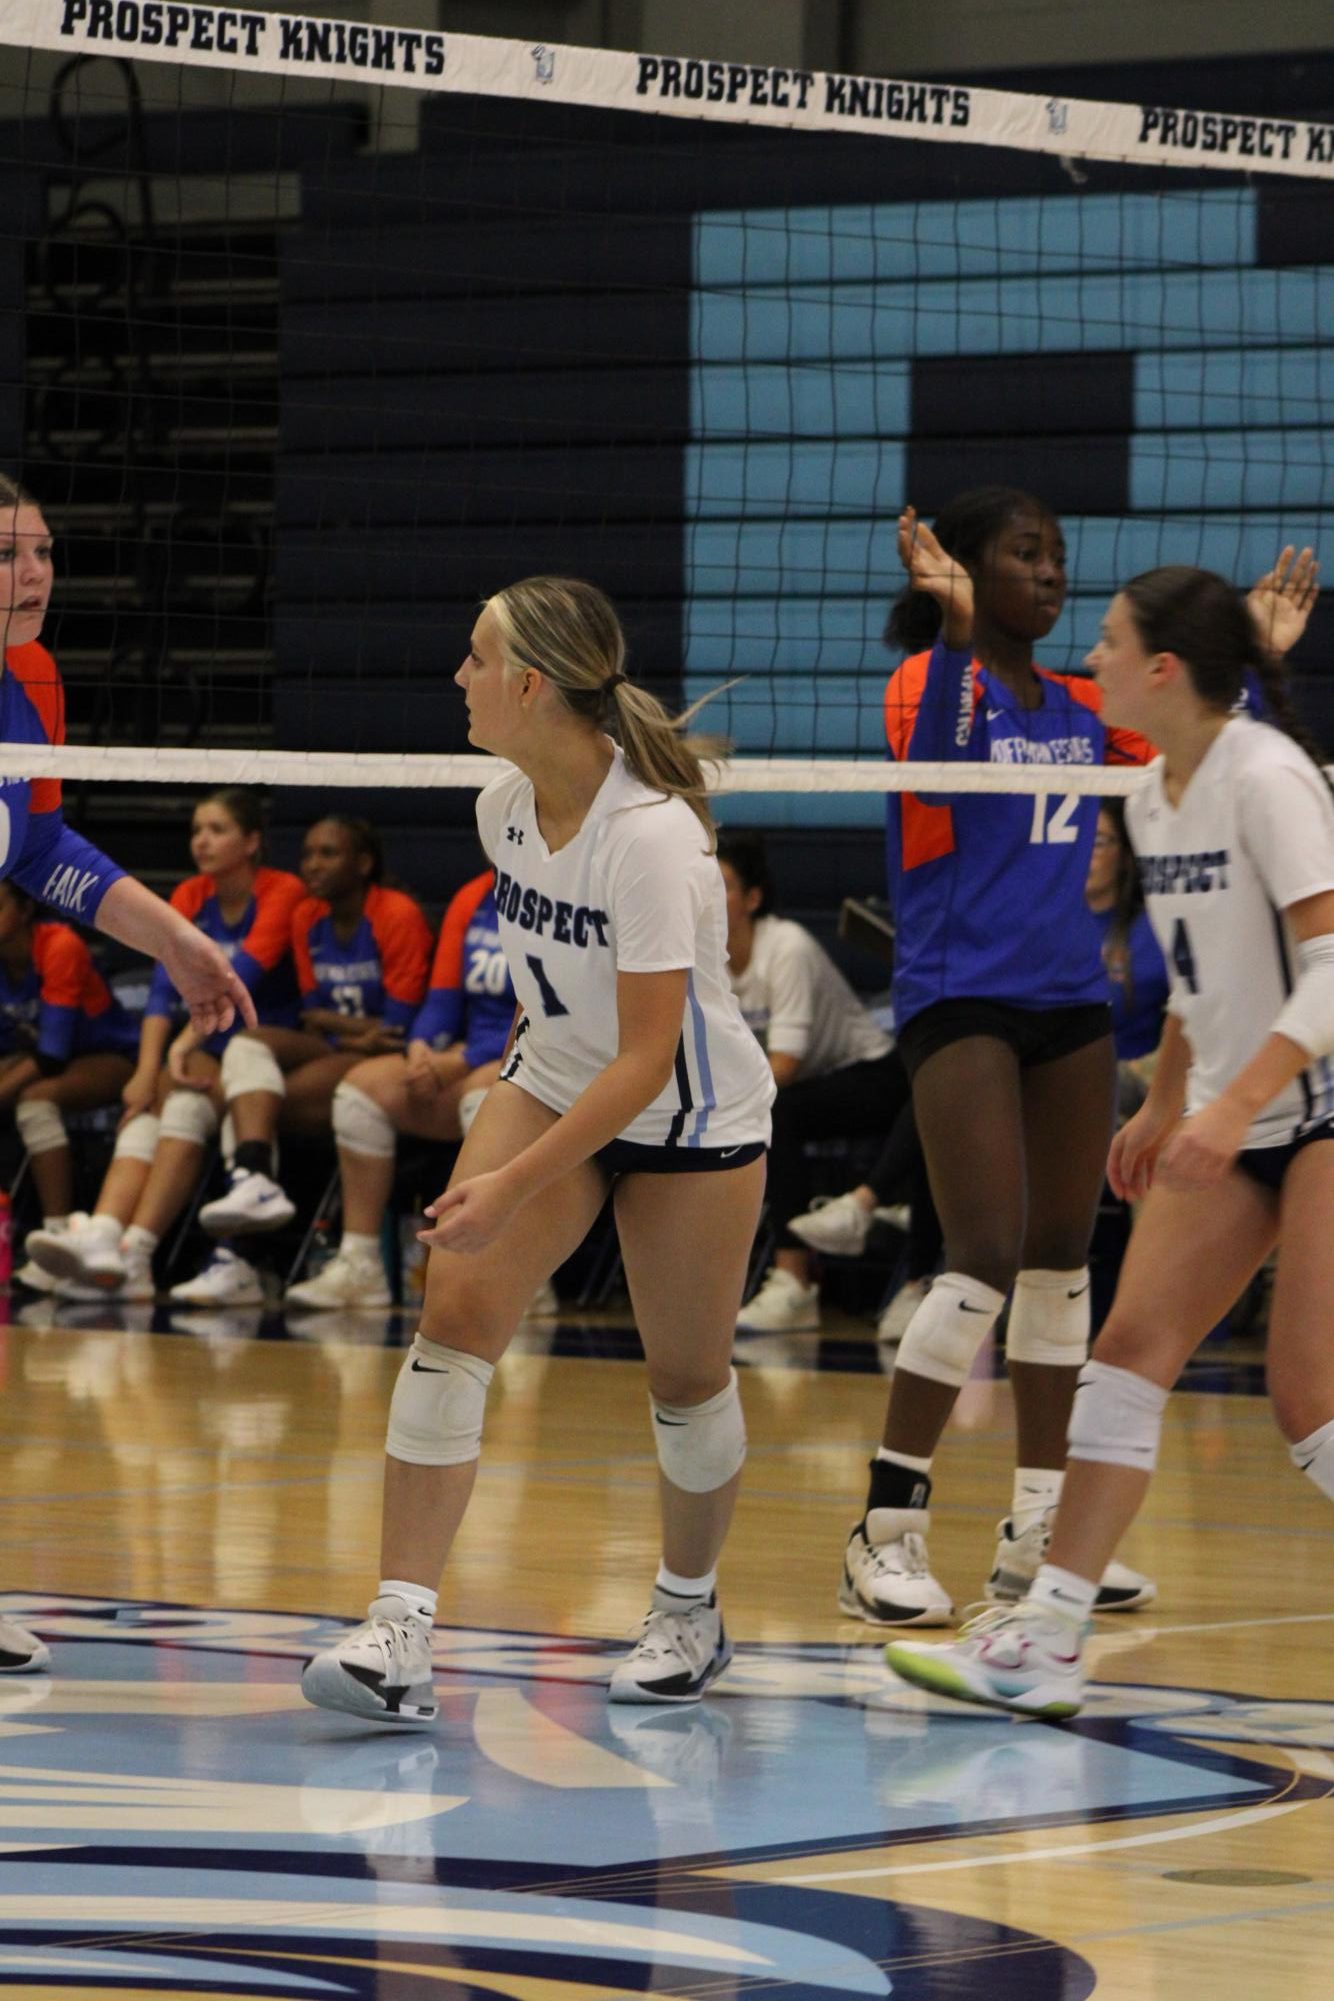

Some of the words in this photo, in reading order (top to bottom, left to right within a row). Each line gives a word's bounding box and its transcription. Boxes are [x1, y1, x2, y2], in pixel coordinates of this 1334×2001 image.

[60, 0, 266, 56] PROSPECT
[279, 18, 446, 75] KNIGHTS
[636, 55, 814, 109] PROSPECT
[825, 75, 970, 127] KNIGHTS
[1138, 106, 1296, 159] PROSPECT
[1029, 793, 1081, 844] 12
[493, 862, 609, 949] ROSPECT
[465, 949, 507, 994] 20
[526, 953, 570, 1018] 1
[1170, 917, 1199, 995] 4
